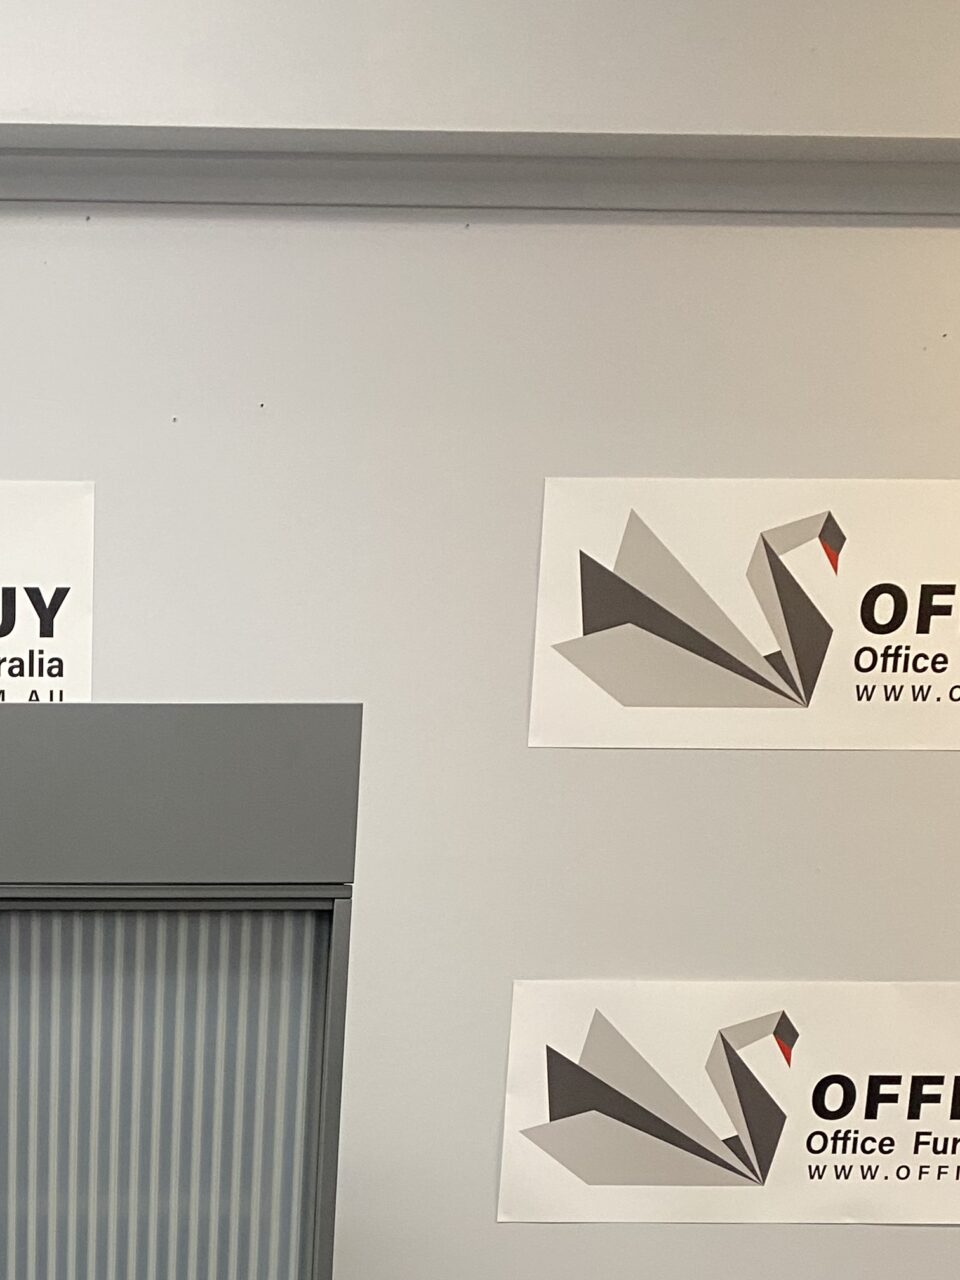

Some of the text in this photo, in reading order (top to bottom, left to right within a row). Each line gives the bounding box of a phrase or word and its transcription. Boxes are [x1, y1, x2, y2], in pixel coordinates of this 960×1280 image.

[859, 582, 958, 636] OF
[853, 644, 950, 674] Office
[811, 1073, 960, 1121] OFFI
[805, 1129, 960, 1156] Office Fur
